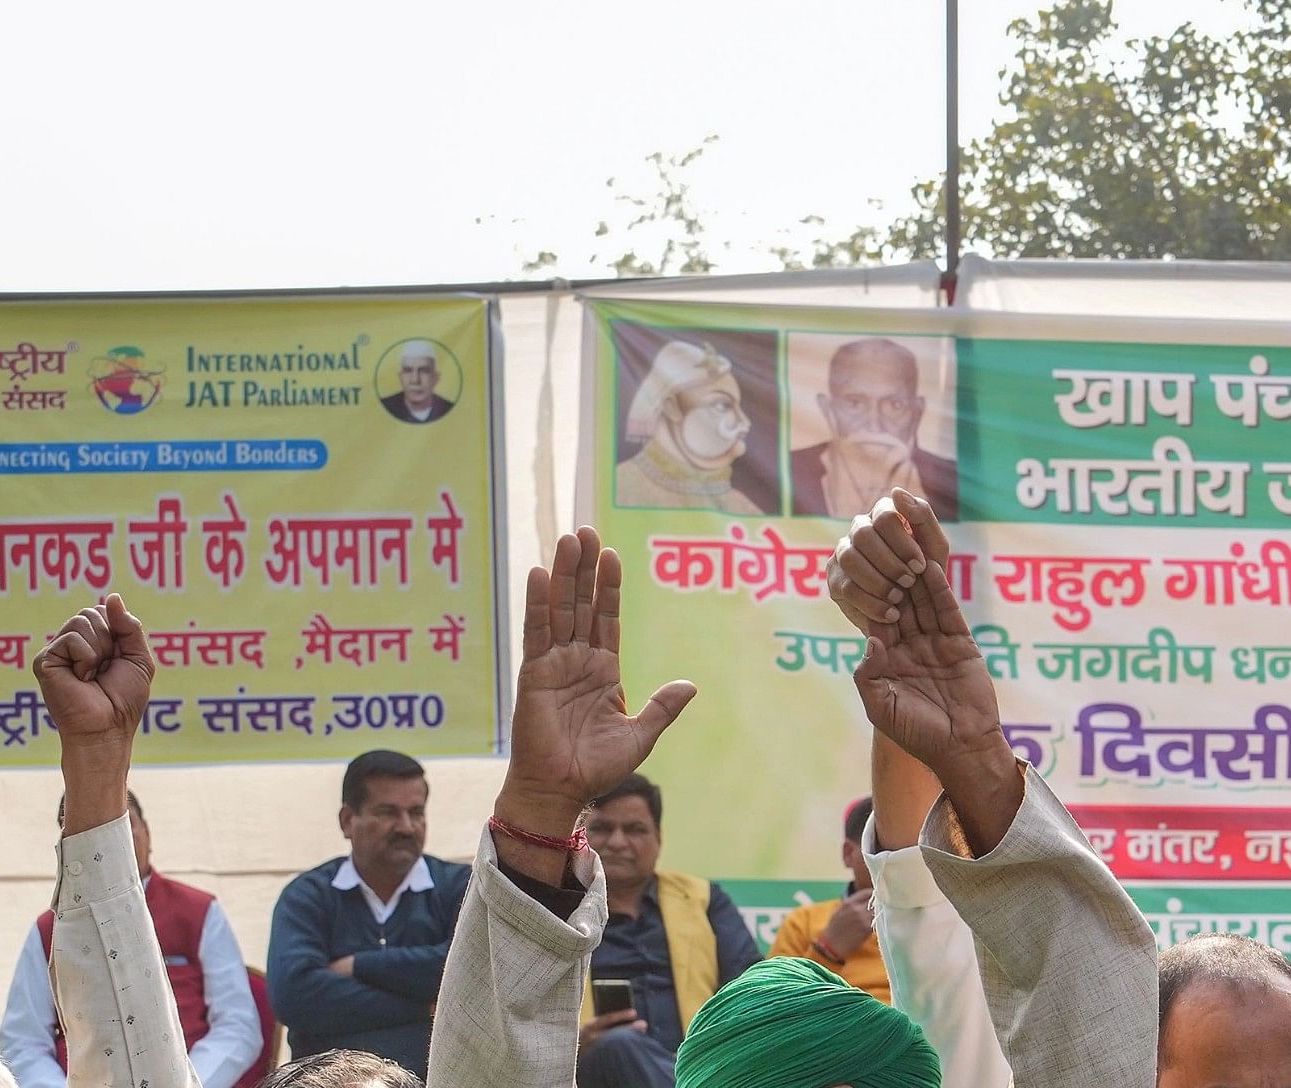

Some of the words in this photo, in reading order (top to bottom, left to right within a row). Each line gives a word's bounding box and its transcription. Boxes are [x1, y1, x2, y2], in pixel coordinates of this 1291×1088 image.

[2, 385, 68, 411] संसद
[185, 381, 236, 408] JAT
[1052, 369, 1196, 428] खाप
[1016, 436, 1251, 517] भारतीय
[129, 498, 187, 588] जी
[203, 494, 246, 587] के
[265, 518, 412, 586] अपमान
[428, 491, 463, 584] मे
[992, 554, 1151, 632] राहुल
[149, 621, 266, 668] संसद
[429, 614, 465, 661] में
[1034, 627, 1215, 684] जगदीप
[198, 686, 315, 735] संसद
